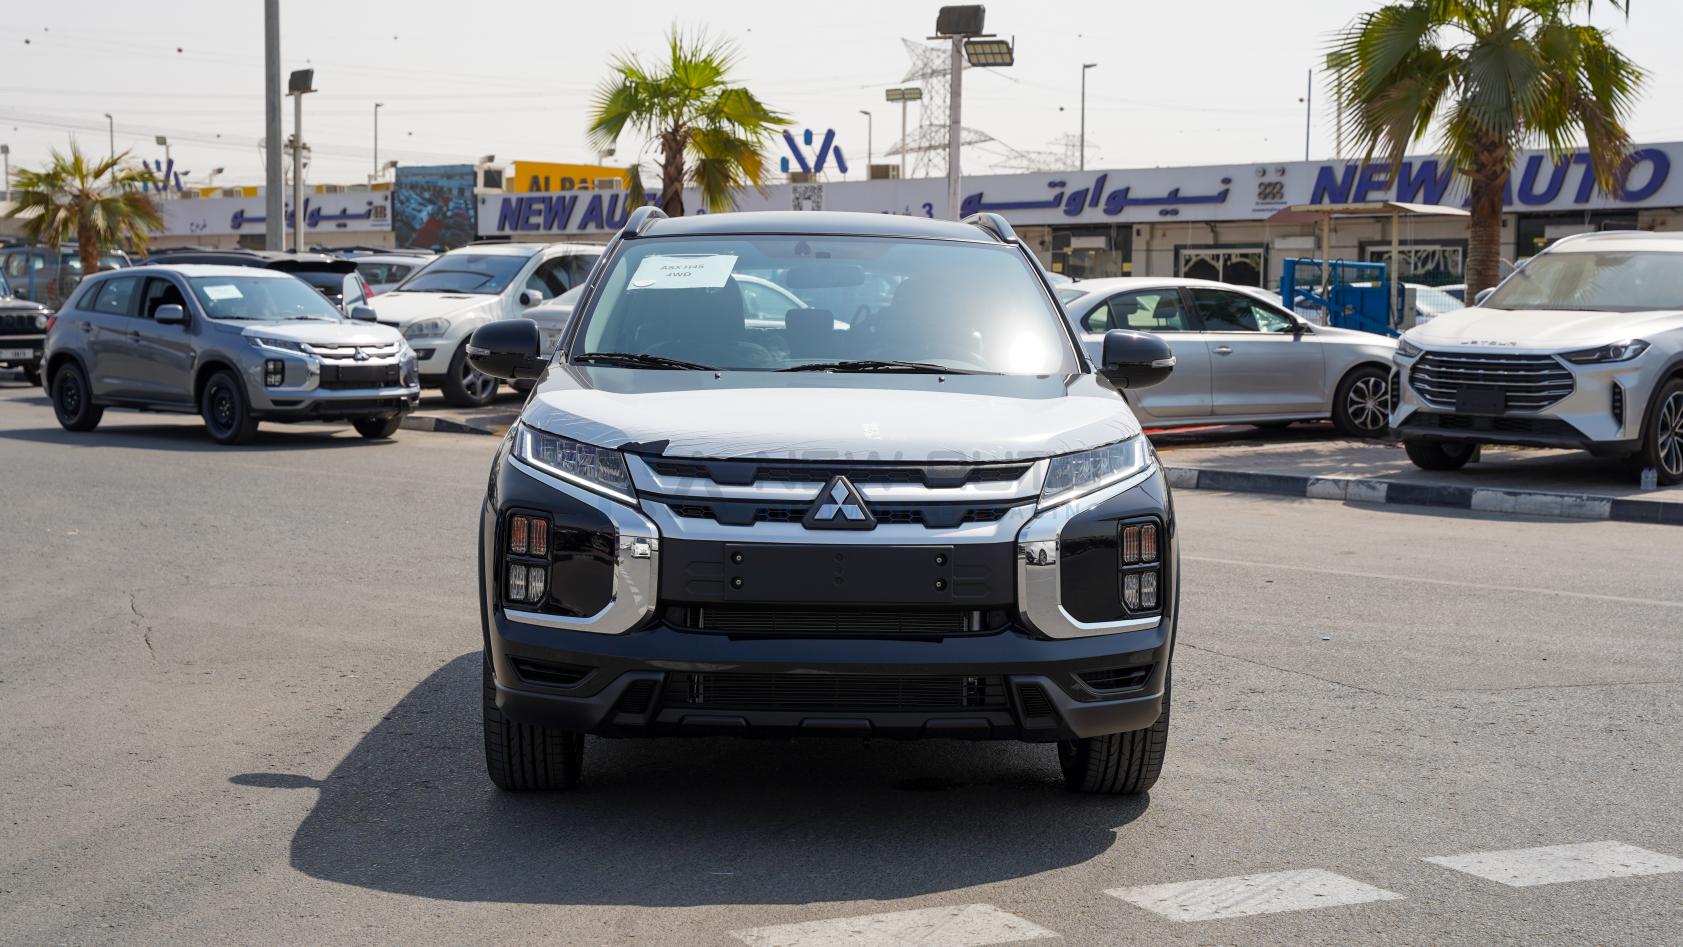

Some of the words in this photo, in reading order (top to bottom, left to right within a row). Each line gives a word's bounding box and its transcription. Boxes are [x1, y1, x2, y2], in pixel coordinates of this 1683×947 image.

[1309, 159, 1459, 205] NEW
[497, 194, 578, 232] NEW
[578, 192, 663, 231] AU
